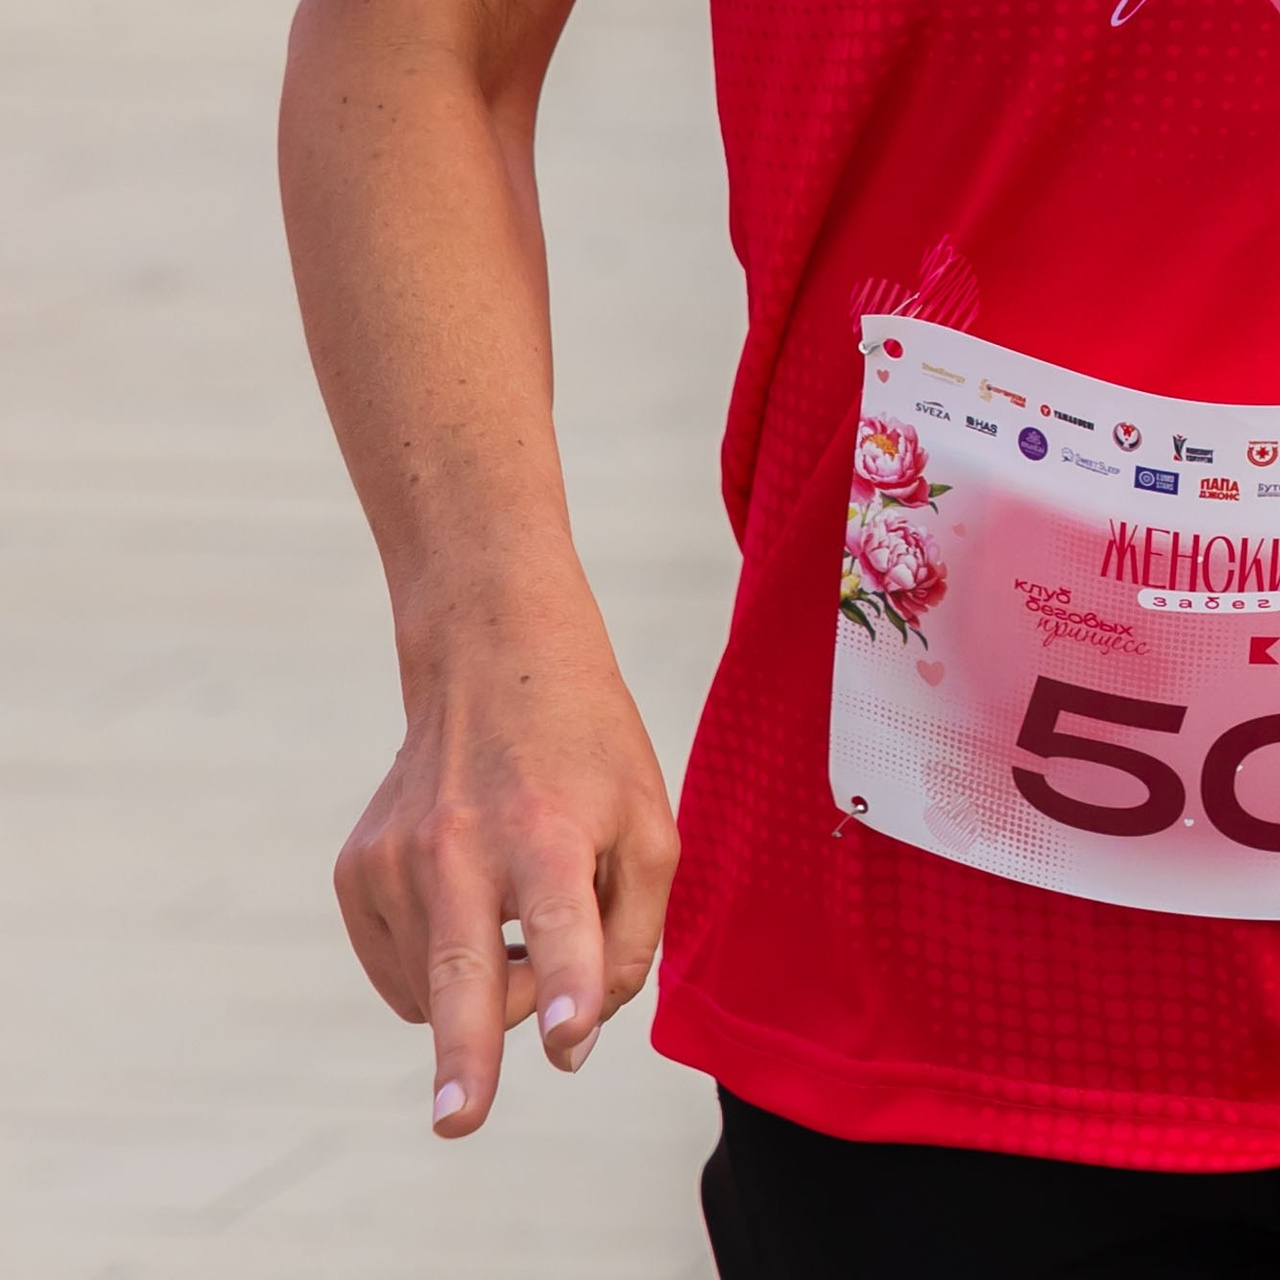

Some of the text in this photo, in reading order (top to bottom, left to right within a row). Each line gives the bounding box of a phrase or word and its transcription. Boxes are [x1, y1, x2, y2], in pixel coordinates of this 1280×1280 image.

[915, 402, 951, 422] SVEZA
[1200, 478, 1240, 493] ПАПА
[1198, 490, 1240, 502] ДЖОНС
[1014, 578, 1072, 605] клуб
[1152, 596, 1271, 610] забег
[1025, 594, 1134, 638] беговых
[1036, 616, 1150, 656] принцесс
